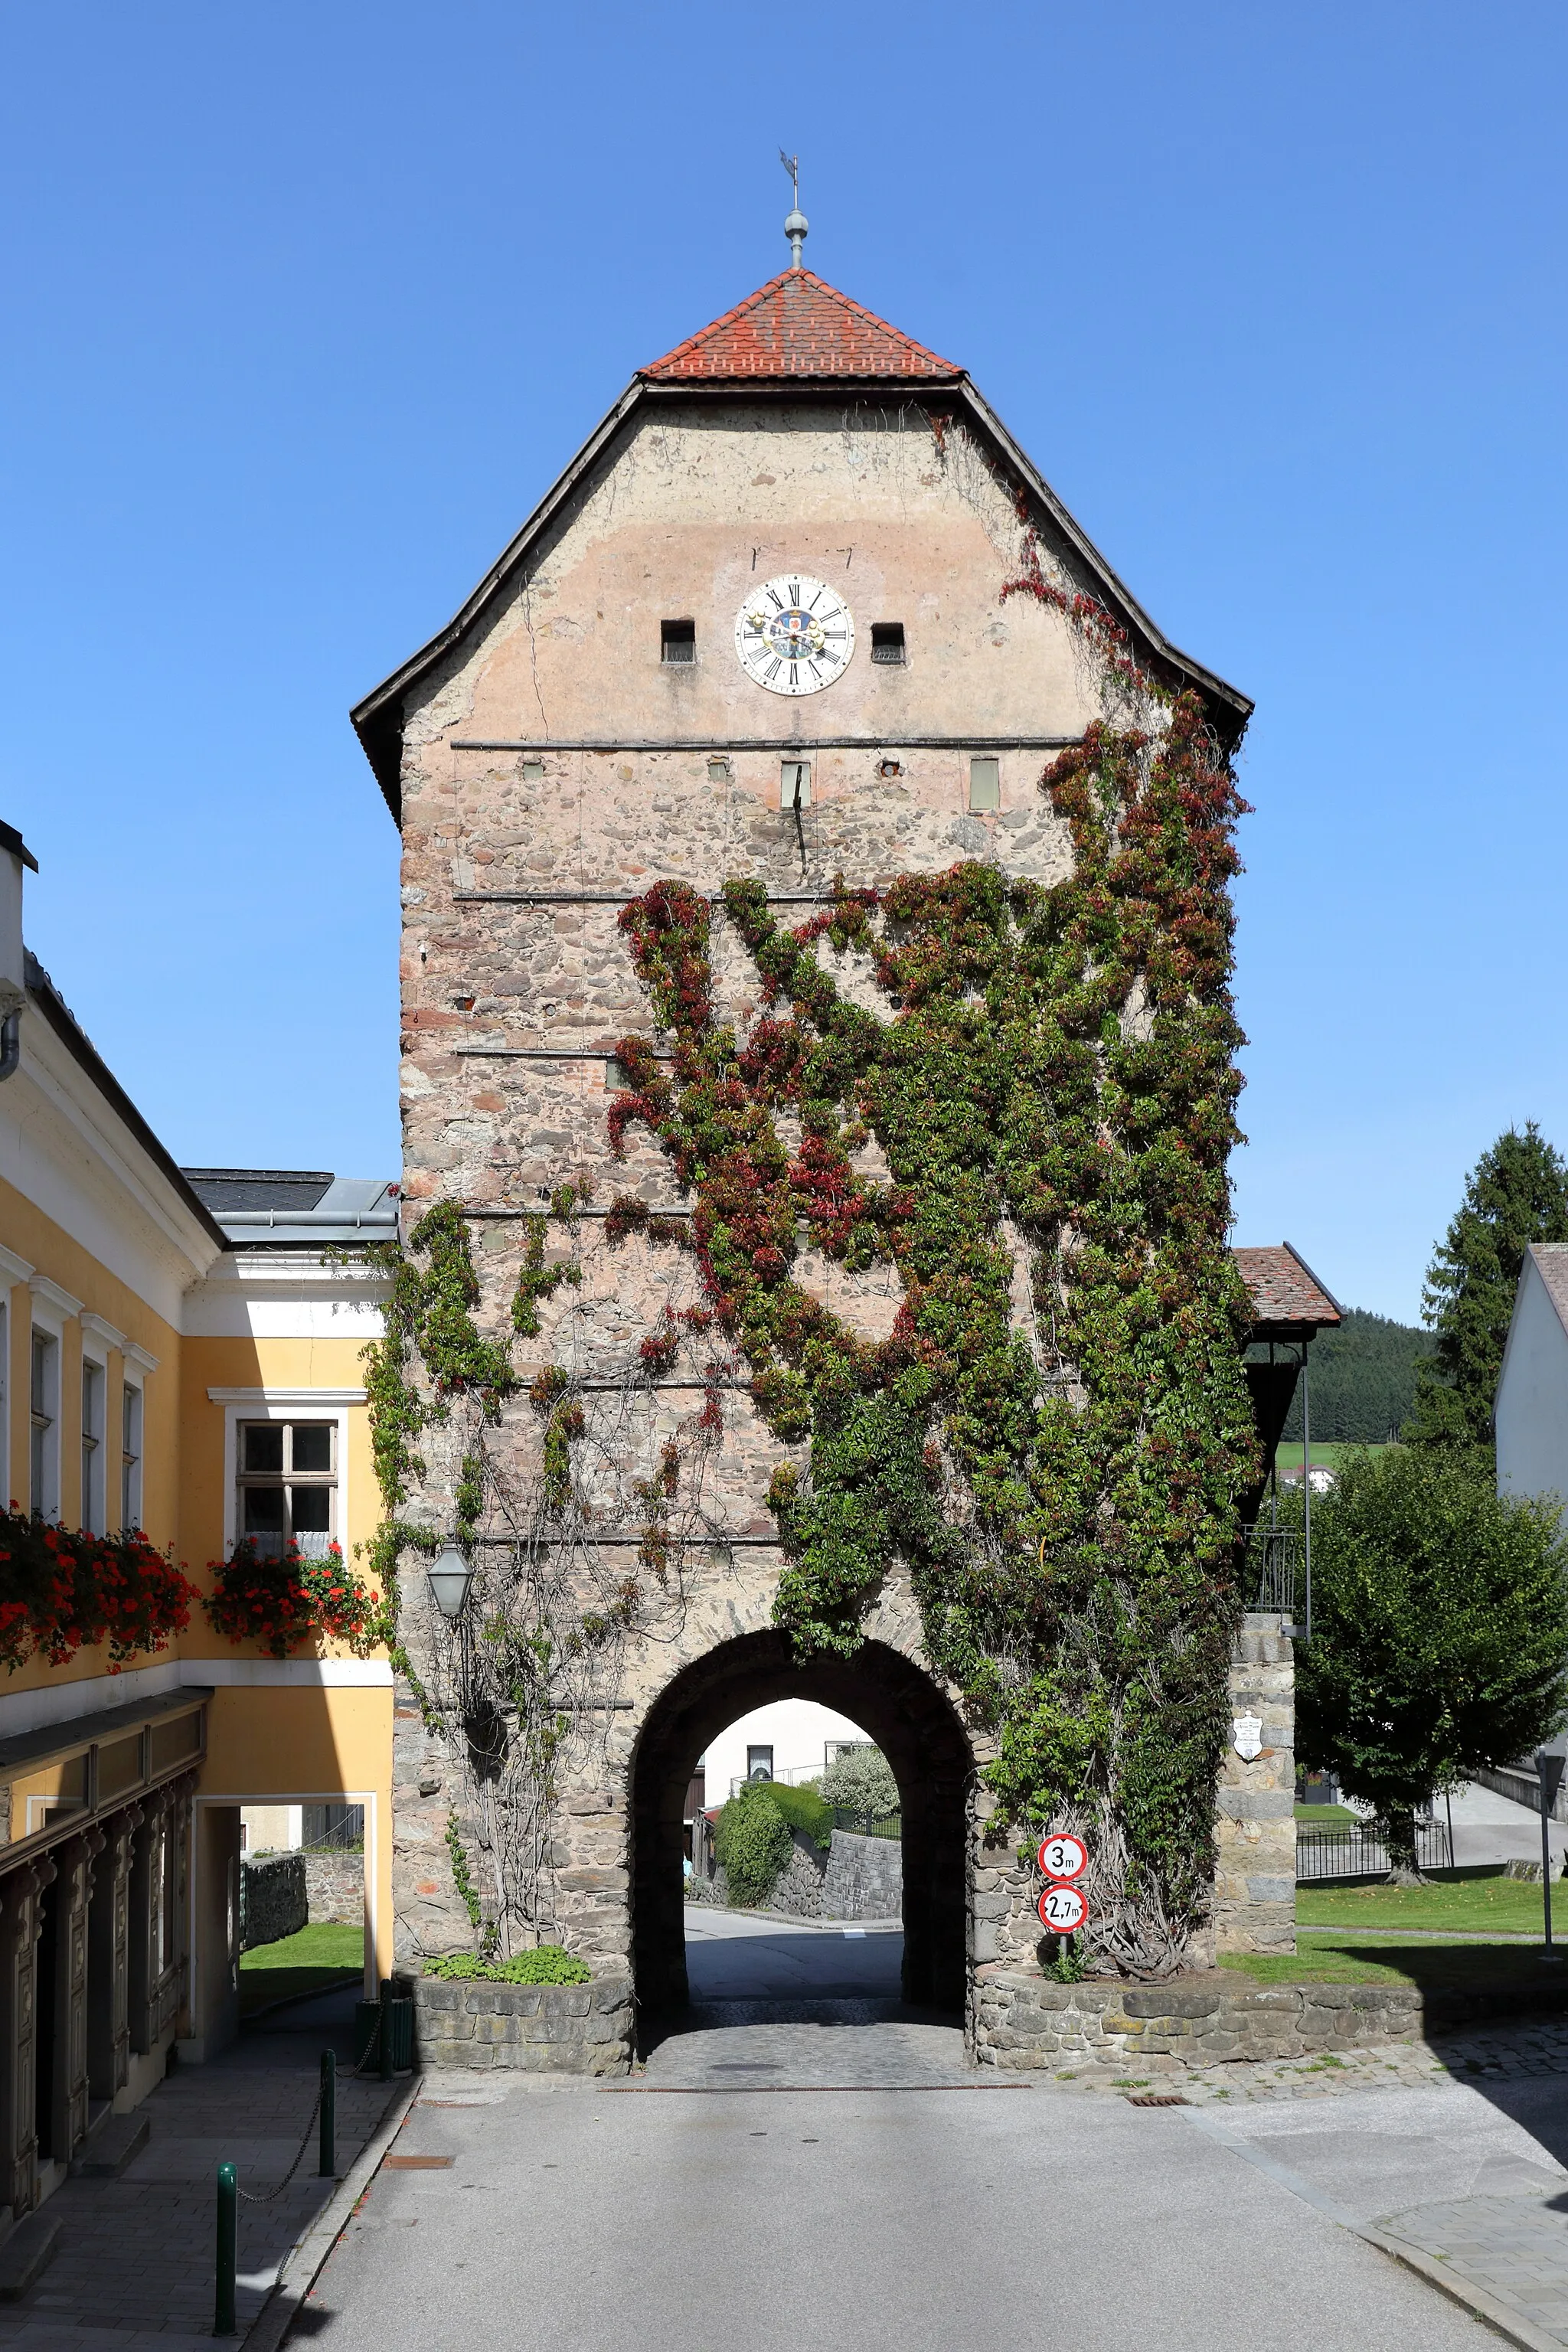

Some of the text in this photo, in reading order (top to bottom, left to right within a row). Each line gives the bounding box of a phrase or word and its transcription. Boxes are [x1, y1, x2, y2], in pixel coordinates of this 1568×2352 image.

[766, 589, 784, 612] XI
[788, 584, 799, 606] XII
[808, 591, 822, 610] I
[819, 608, 841, 623] II
